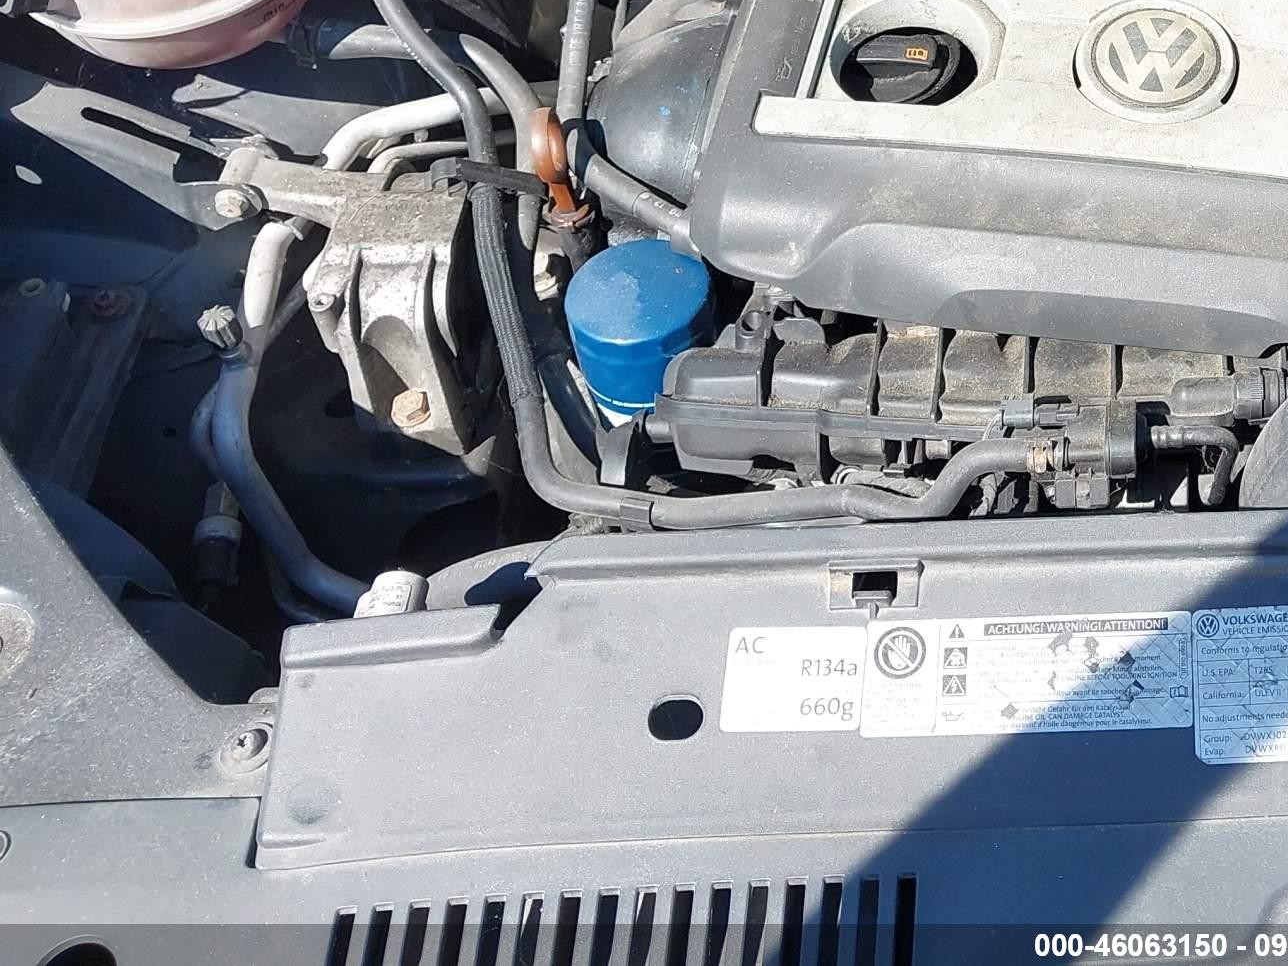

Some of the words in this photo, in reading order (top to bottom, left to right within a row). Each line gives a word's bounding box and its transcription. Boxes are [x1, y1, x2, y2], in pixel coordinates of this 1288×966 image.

[987, 623, 1045, 635] ACHTUNG!
[1104, 618, 1166, 630] ATTENTION!
[1222, 625, 1256, 635] VEHICLE
[735, 636, 768, 655] AC
[1201, 645, 1239, 656] Conforms
[1241, 644, 1250, 654] to
[801, 658, 858, 676] R134a
[1202, 690, 1246, 701] California:
[800, 696, 854, 721] 660g
[1047, 705, 1070, 713] Gefahr
[1202, 714, 1214, 724] No
[1214, 713, 1265, 726] adjustments
[1204, 734, 1233, 745] Group:
